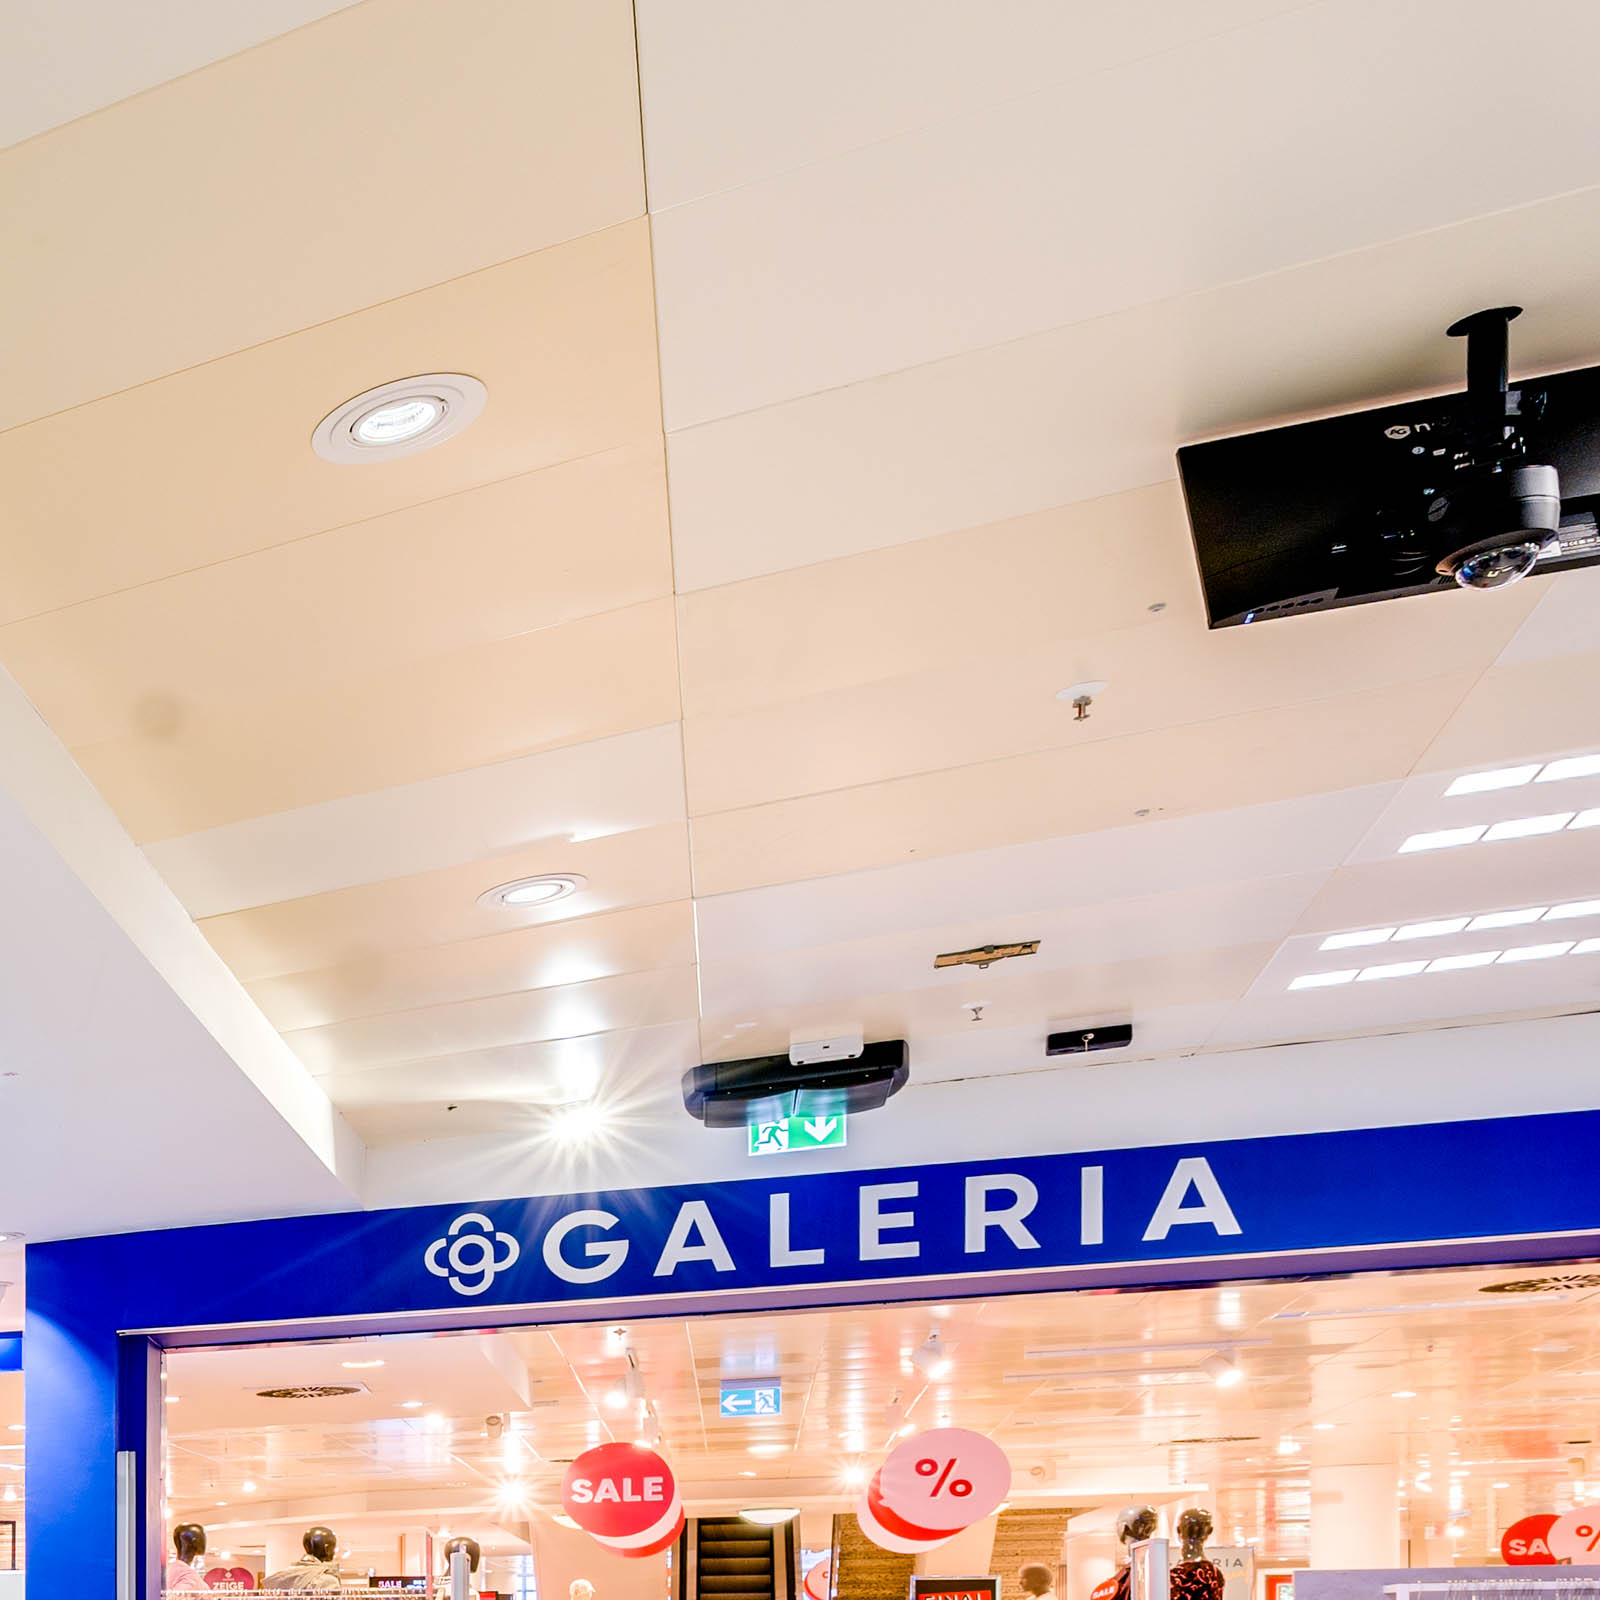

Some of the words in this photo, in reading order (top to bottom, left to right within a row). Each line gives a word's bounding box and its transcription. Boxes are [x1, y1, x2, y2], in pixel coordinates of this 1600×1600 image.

[542, 1157, 1243, 1286] GALERIA
[915, 1457, 973, 1498] %
[570, 1475, 664, 1504] SALE
[1508, 1538, 1550, 1556] SA
[378, 1580, 401, 1589] SALE
[1092, 1586, 1115, 1600] SALE
